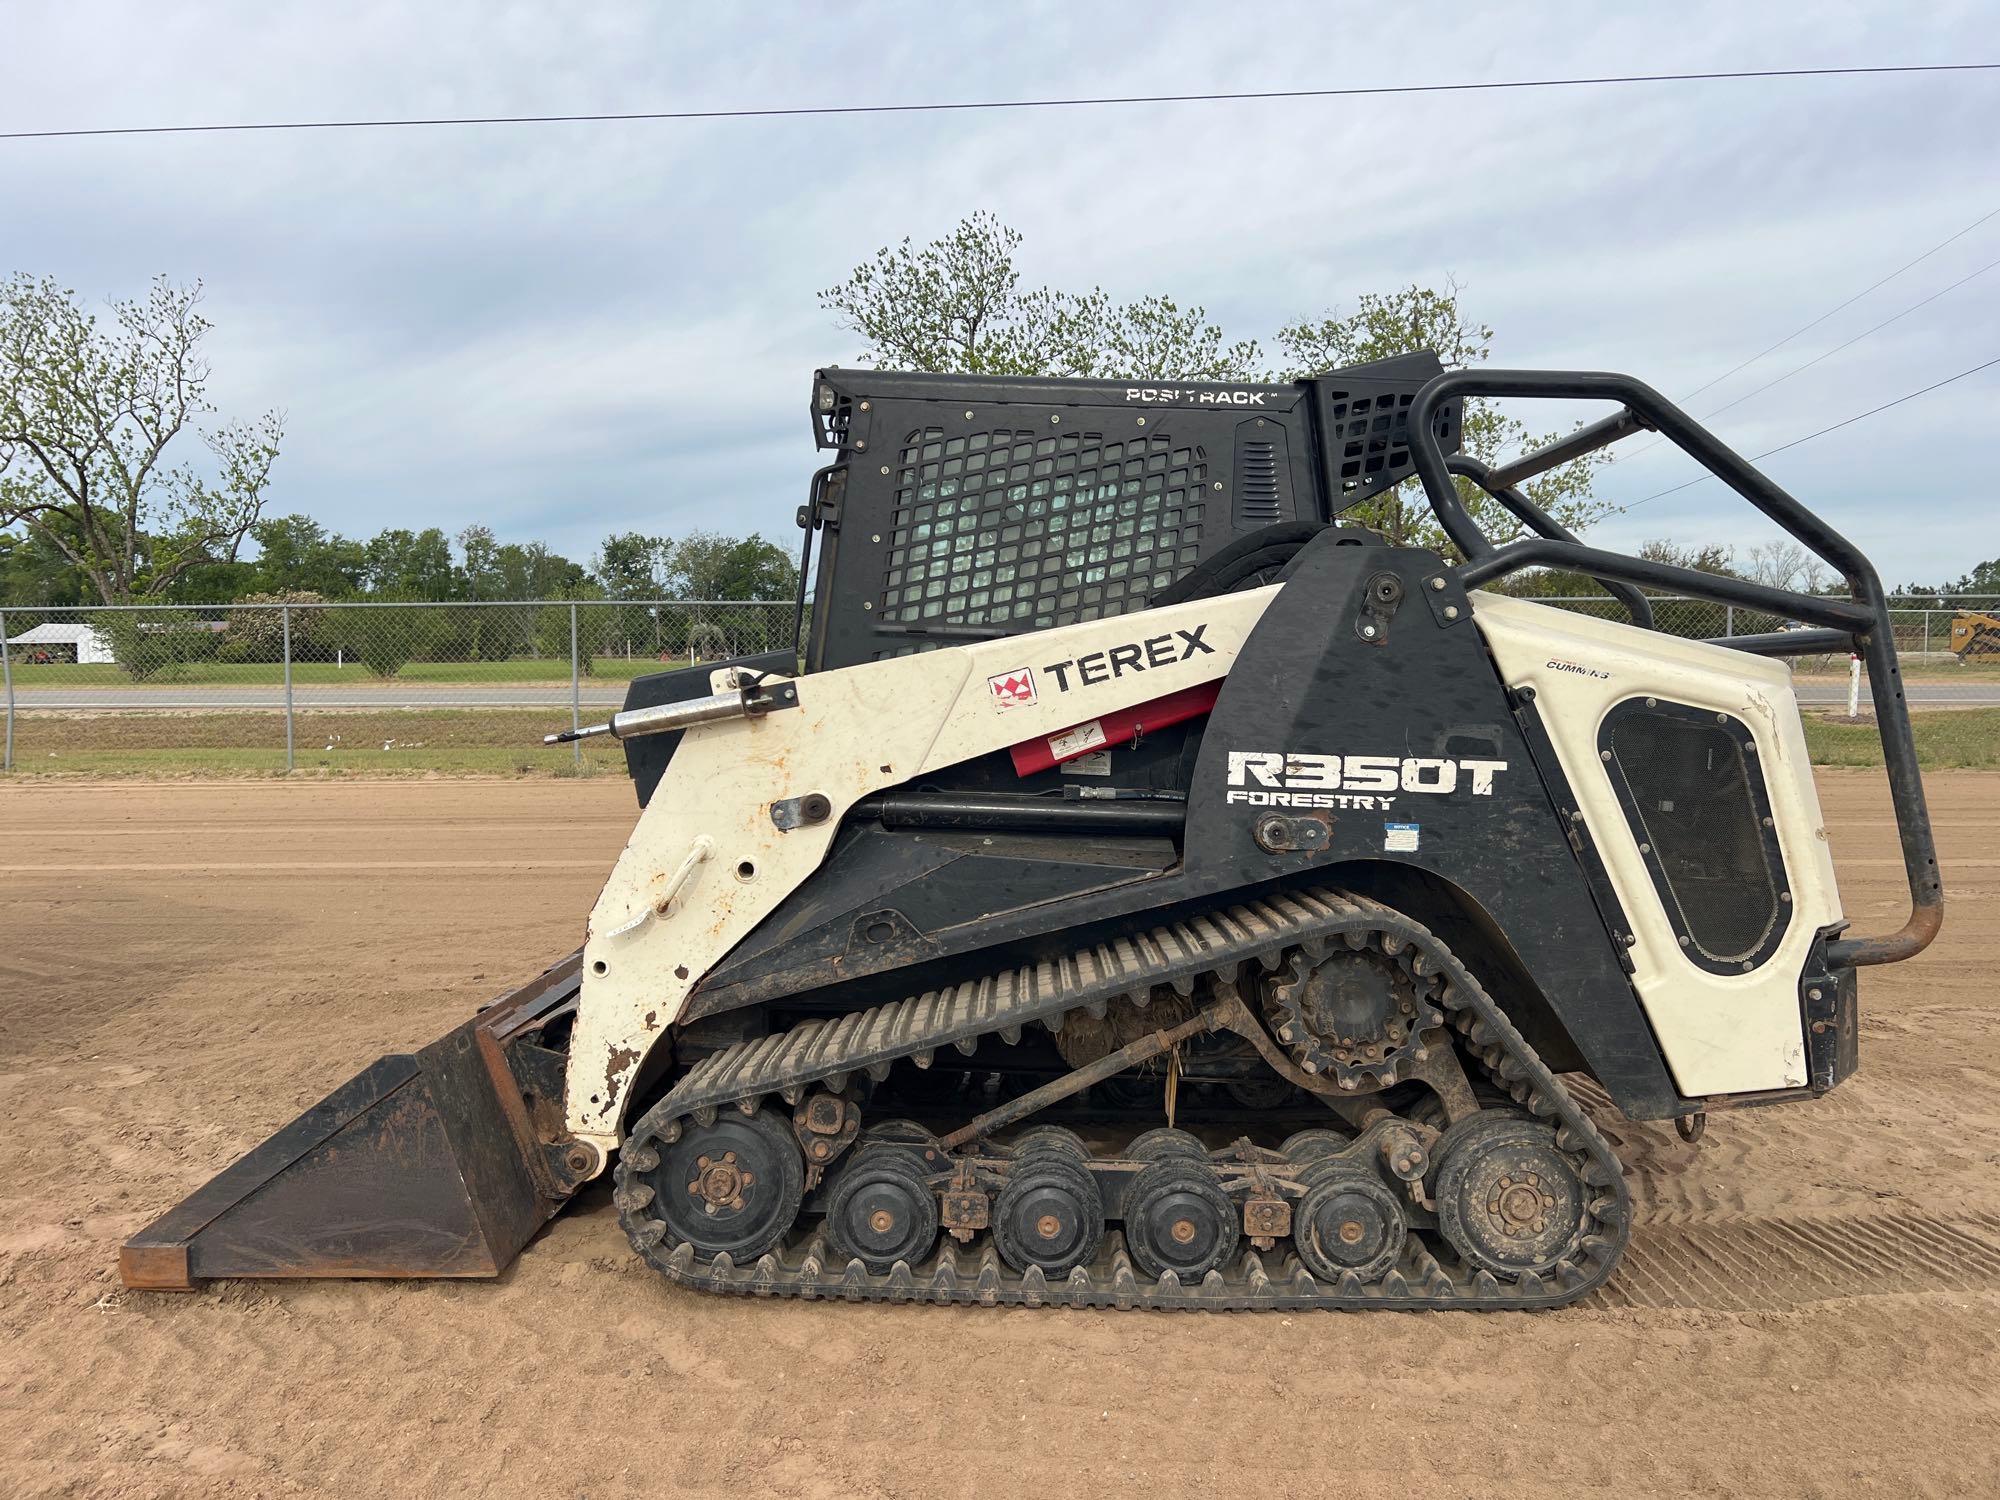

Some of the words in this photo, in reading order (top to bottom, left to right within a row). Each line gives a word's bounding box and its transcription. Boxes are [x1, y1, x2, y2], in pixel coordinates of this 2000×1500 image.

[1043, 623, 1216, 693] TEREX
[1227, 751, 1508, 796] R350T
[1226, 790, 1397, 811] FORESTRY
